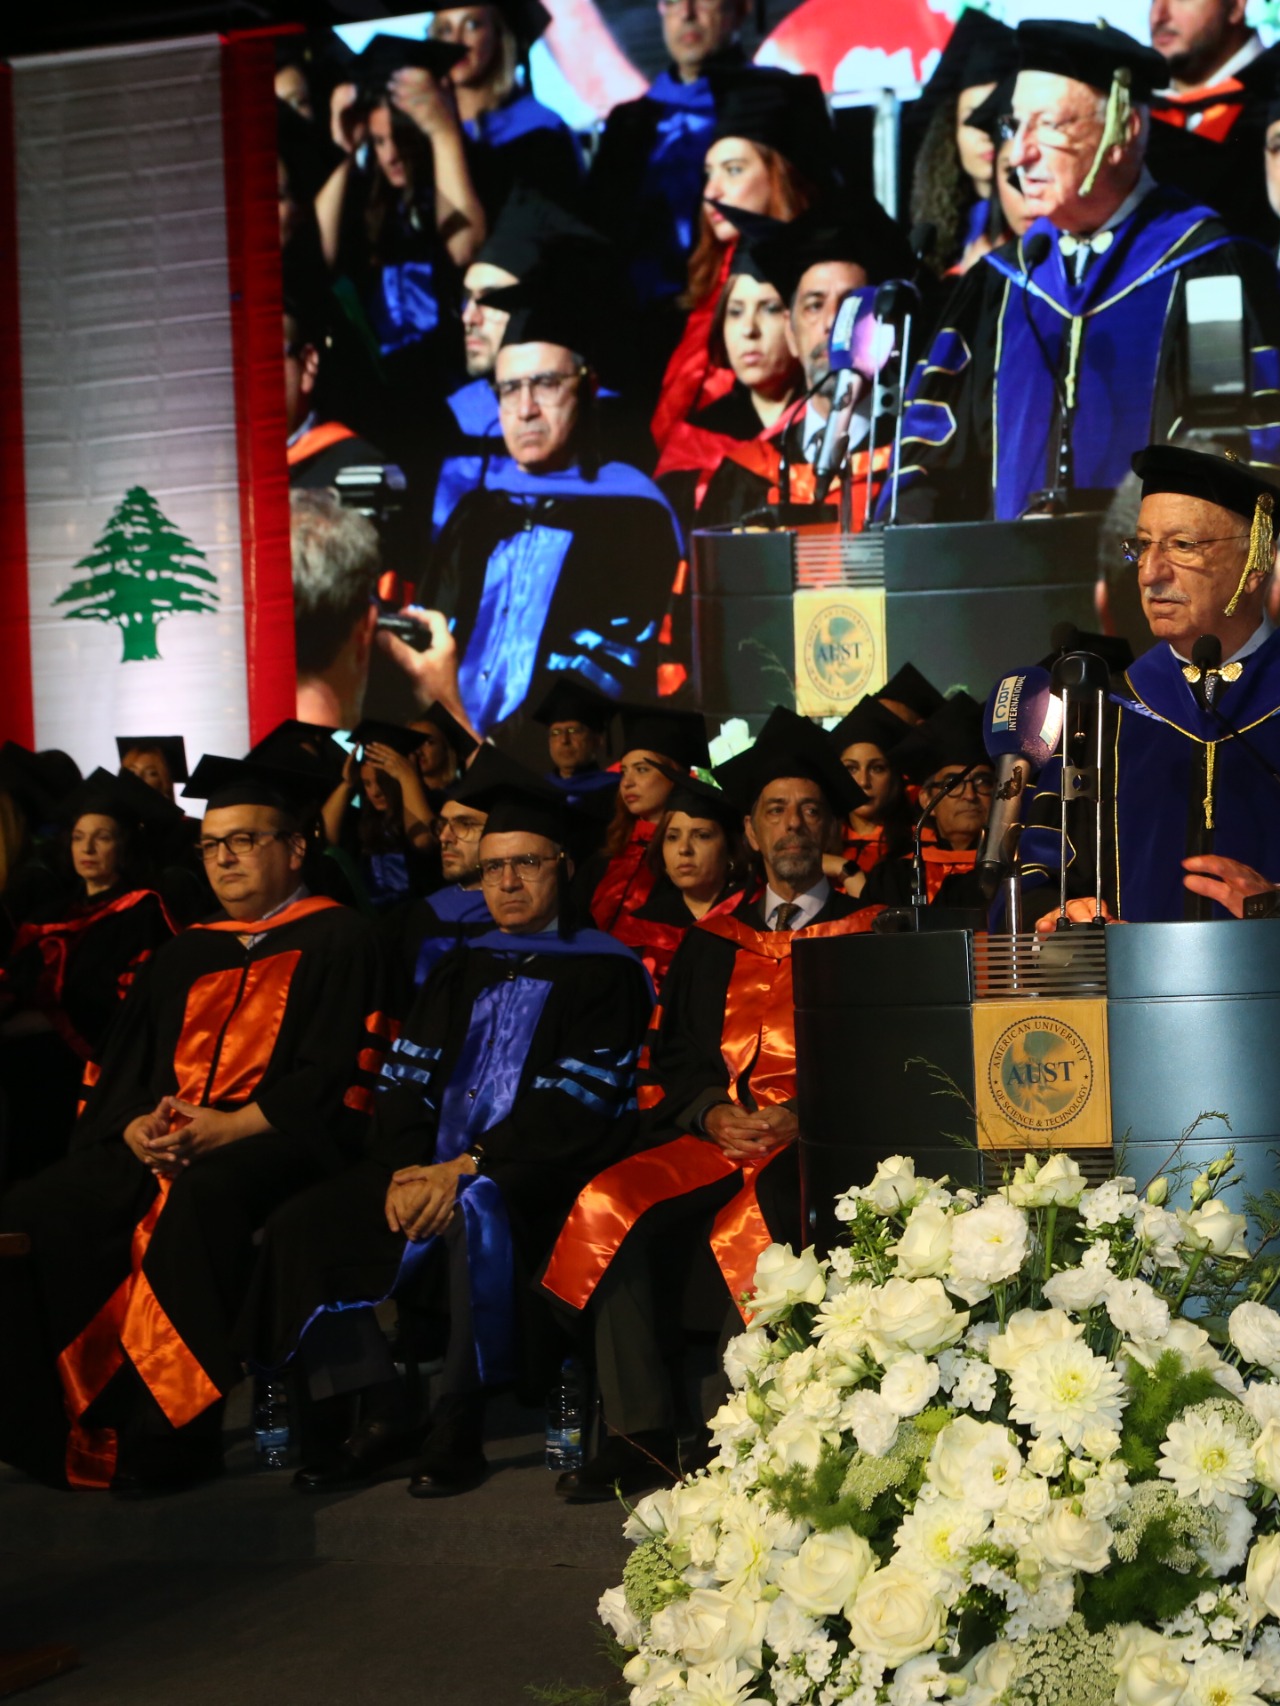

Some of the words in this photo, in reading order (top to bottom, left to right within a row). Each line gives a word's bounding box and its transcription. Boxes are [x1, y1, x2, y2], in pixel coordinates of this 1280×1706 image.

[995, 680, 1010, 718] LBC
[1009, 675, 1026, 731] INTERNATIONAL
[993, 1022, 1031, 1069] AMERICAN
[1034, 1021, 1087, 1062] UNIVERSITY
[1007, 1061, 1075, 1086] AUST
[996, 1089, 1006, 1101] OF
[1003, 1101, 1035, 1126] SCIENCE
[1035, 1119, 1043, 1127] &
[1044, 1083, 1088, 1127] TECHNOLOGY
